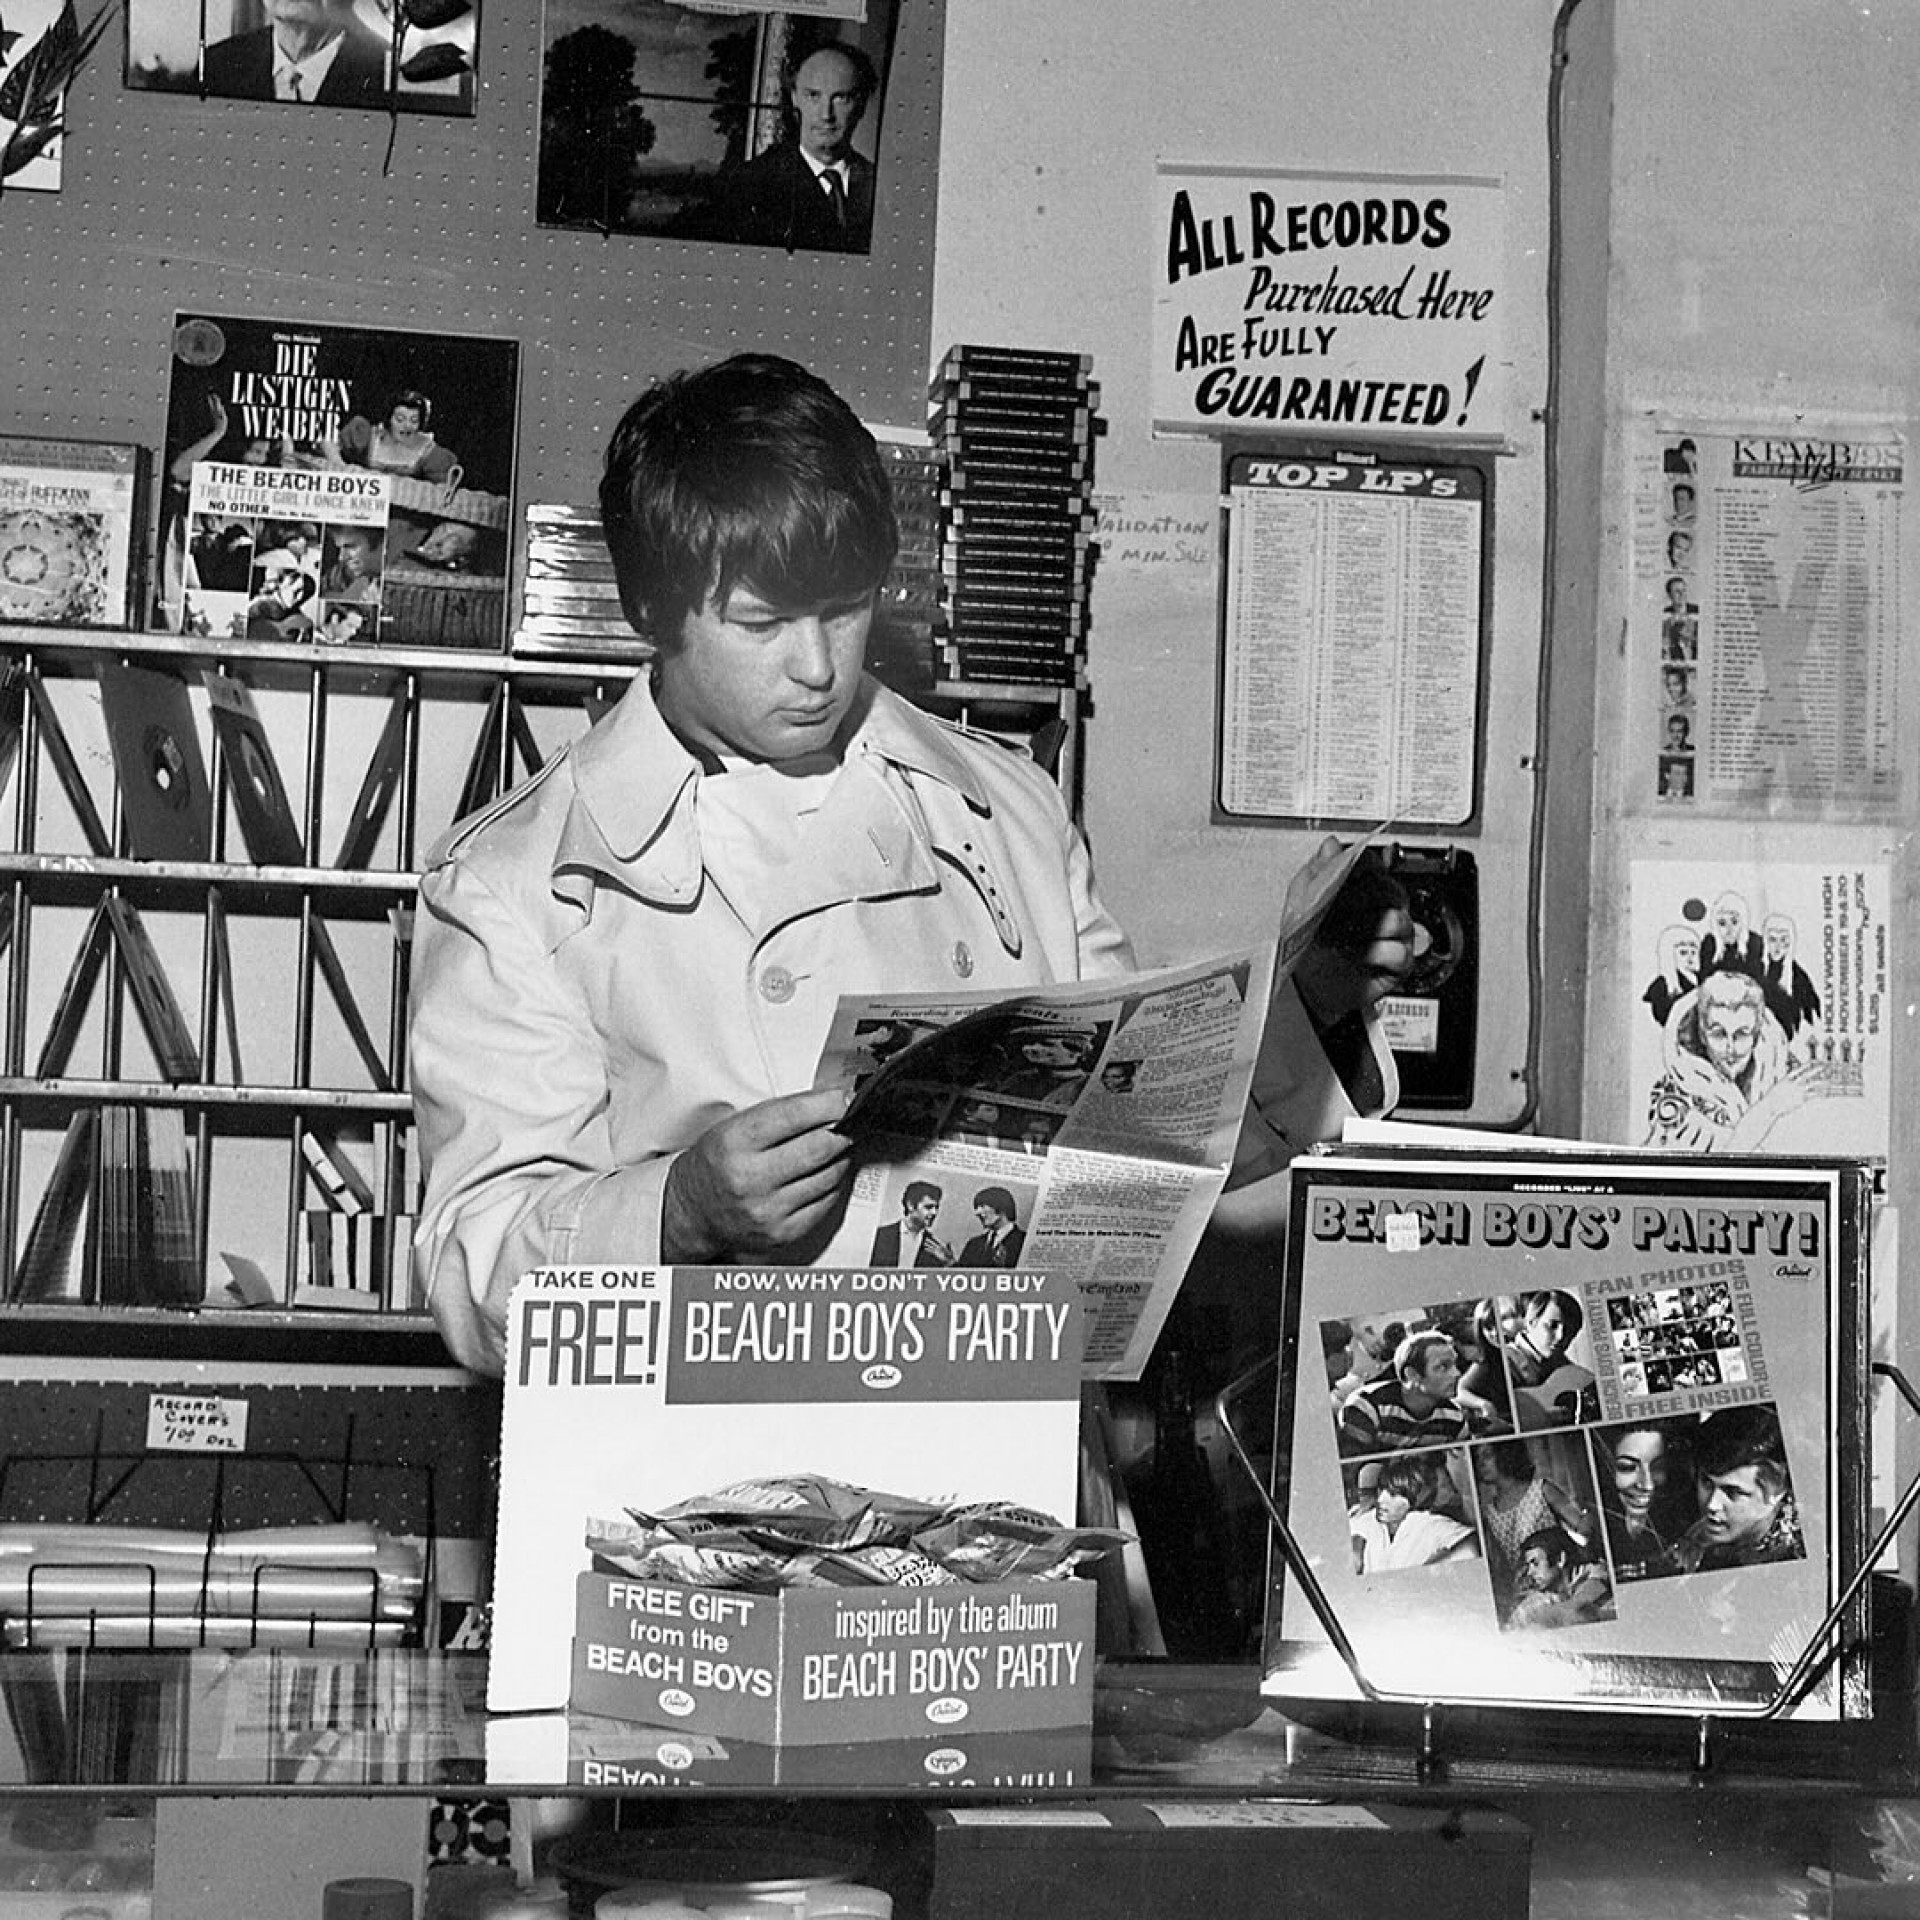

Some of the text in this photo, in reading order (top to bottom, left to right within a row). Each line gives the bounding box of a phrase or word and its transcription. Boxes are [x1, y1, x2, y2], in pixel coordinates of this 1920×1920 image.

[1168, 189, 1451, 284] ALL RECORDS
[1244, 264, 1494, 321] Purchased Here
[276, 342, 317, 376] DIE
[1175, 315, 1337, 372] ARE FULLY
[232, 371, 353, 412] LUSTIGEN
[242, 404, 342, 444] WEIBER
[208, 465, 381, 496] THE BEACH BOYS
[1248, 463, 1349, 488] TOP
[207, 500, 225, 511] NO
[230, 502, 271, 514] OTHER
[1822, 875, 1835, 1034] HOLLYWOOD HIGH
[1838, 934, 1849, 1034] NOVEMBER
[1313, 1197, 1470, 1246] BEACH
[1484, 1203, 1620, 1250] BOYS'
[1633, 1206, 1818, 1257] PARTY!
[532, 1270, 656, 1289] TAKE ONE
[713, 1271, 1047, 1292] NOW, WHY DON'T YOU BUY
[1584, 1258, 1745, 1296] FAN PHOTOS
[518, 1300, 661, 1386] FREE!
[685, 1301, 814, 1363] BEACH
[827, 1302, 937, 1363] BOYS'
[948, 1302, 1070, 1361] PARTY
[154, 1398, 217, 1411] RECORD
[1624, 1383, 1774, 1418] FREE INSIDE
[608, 1582, 755, 1627] FREE GIFT
[835, 1592, 1058, 1647] inspired by the album
[630, 1618, 729, 1653] from the
[587, 1643, 773, 1697] BEACH BOYS
[803, 1641, 1084, 1701] BEACH BOYS' PARTY
